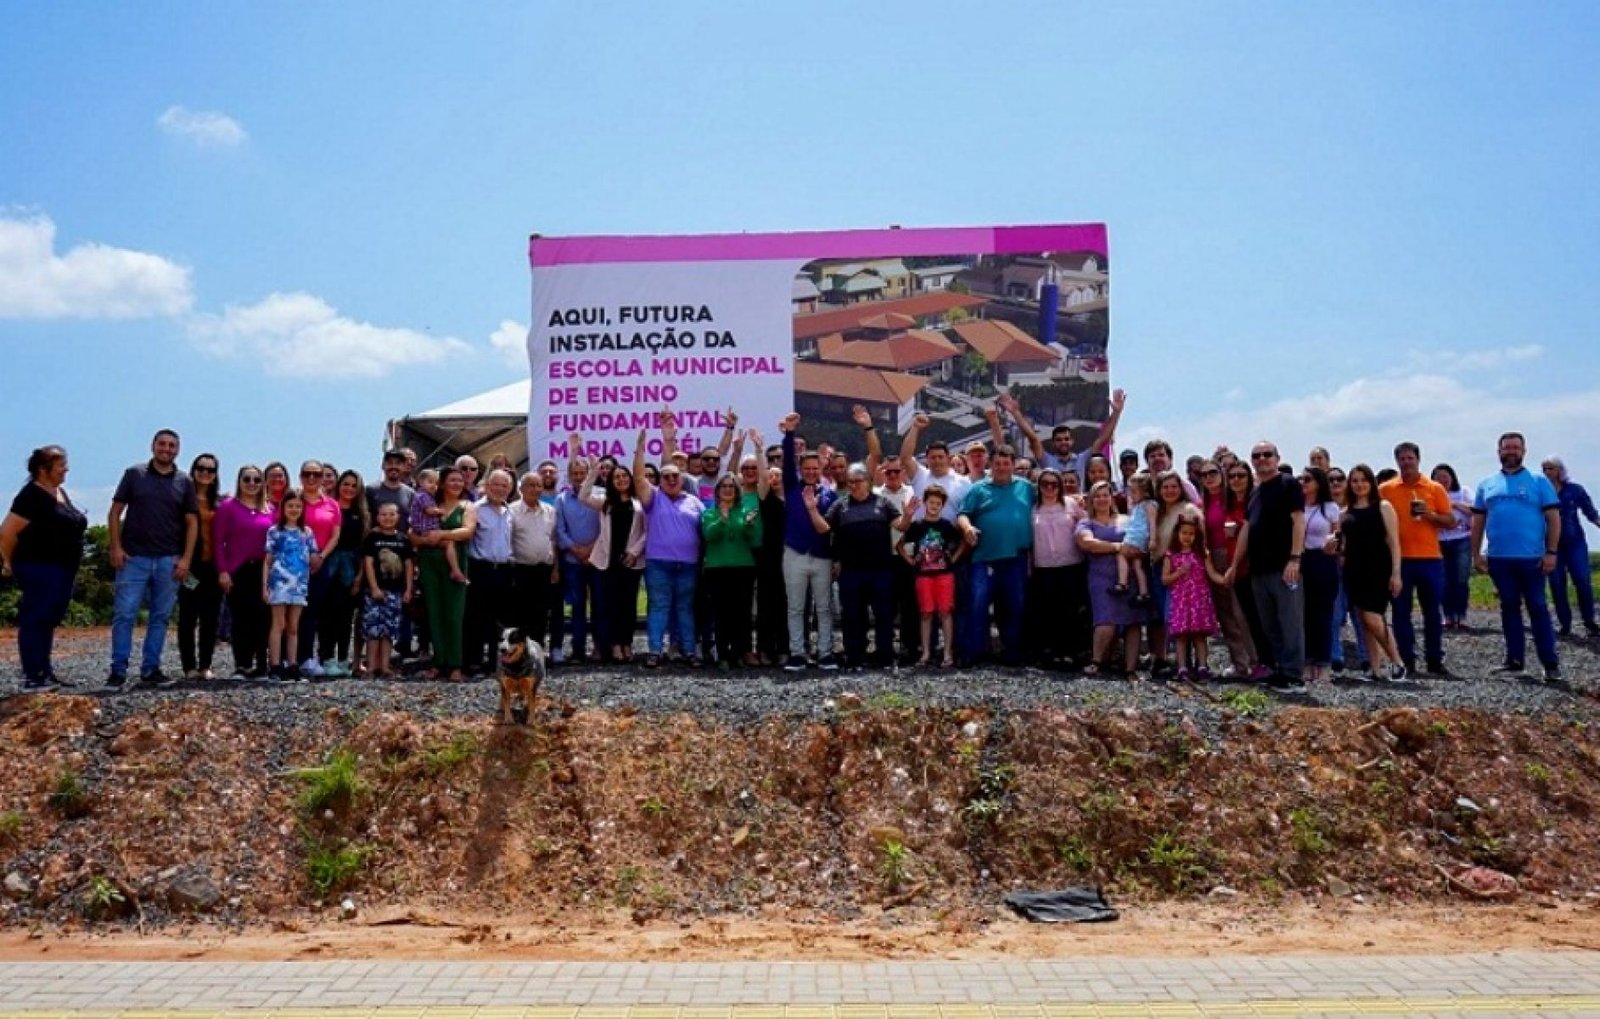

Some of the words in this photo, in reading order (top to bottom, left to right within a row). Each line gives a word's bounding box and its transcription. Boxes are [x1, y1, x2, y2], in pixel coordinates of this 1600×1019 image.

[549, 308, 611, 327] AQUI,
[619, 305, 713, 323] FUTURA
[550, 327, 696, 355] INSTALAÇÃO
[704, 331, 736, 348] DA
[549, 359, 643, 379] ESCOLA
[651, 357, 784, 376] MUNICIPAL
[549, 388, 578, 405] DE
[587, 385, 678, 404] ENSINO
